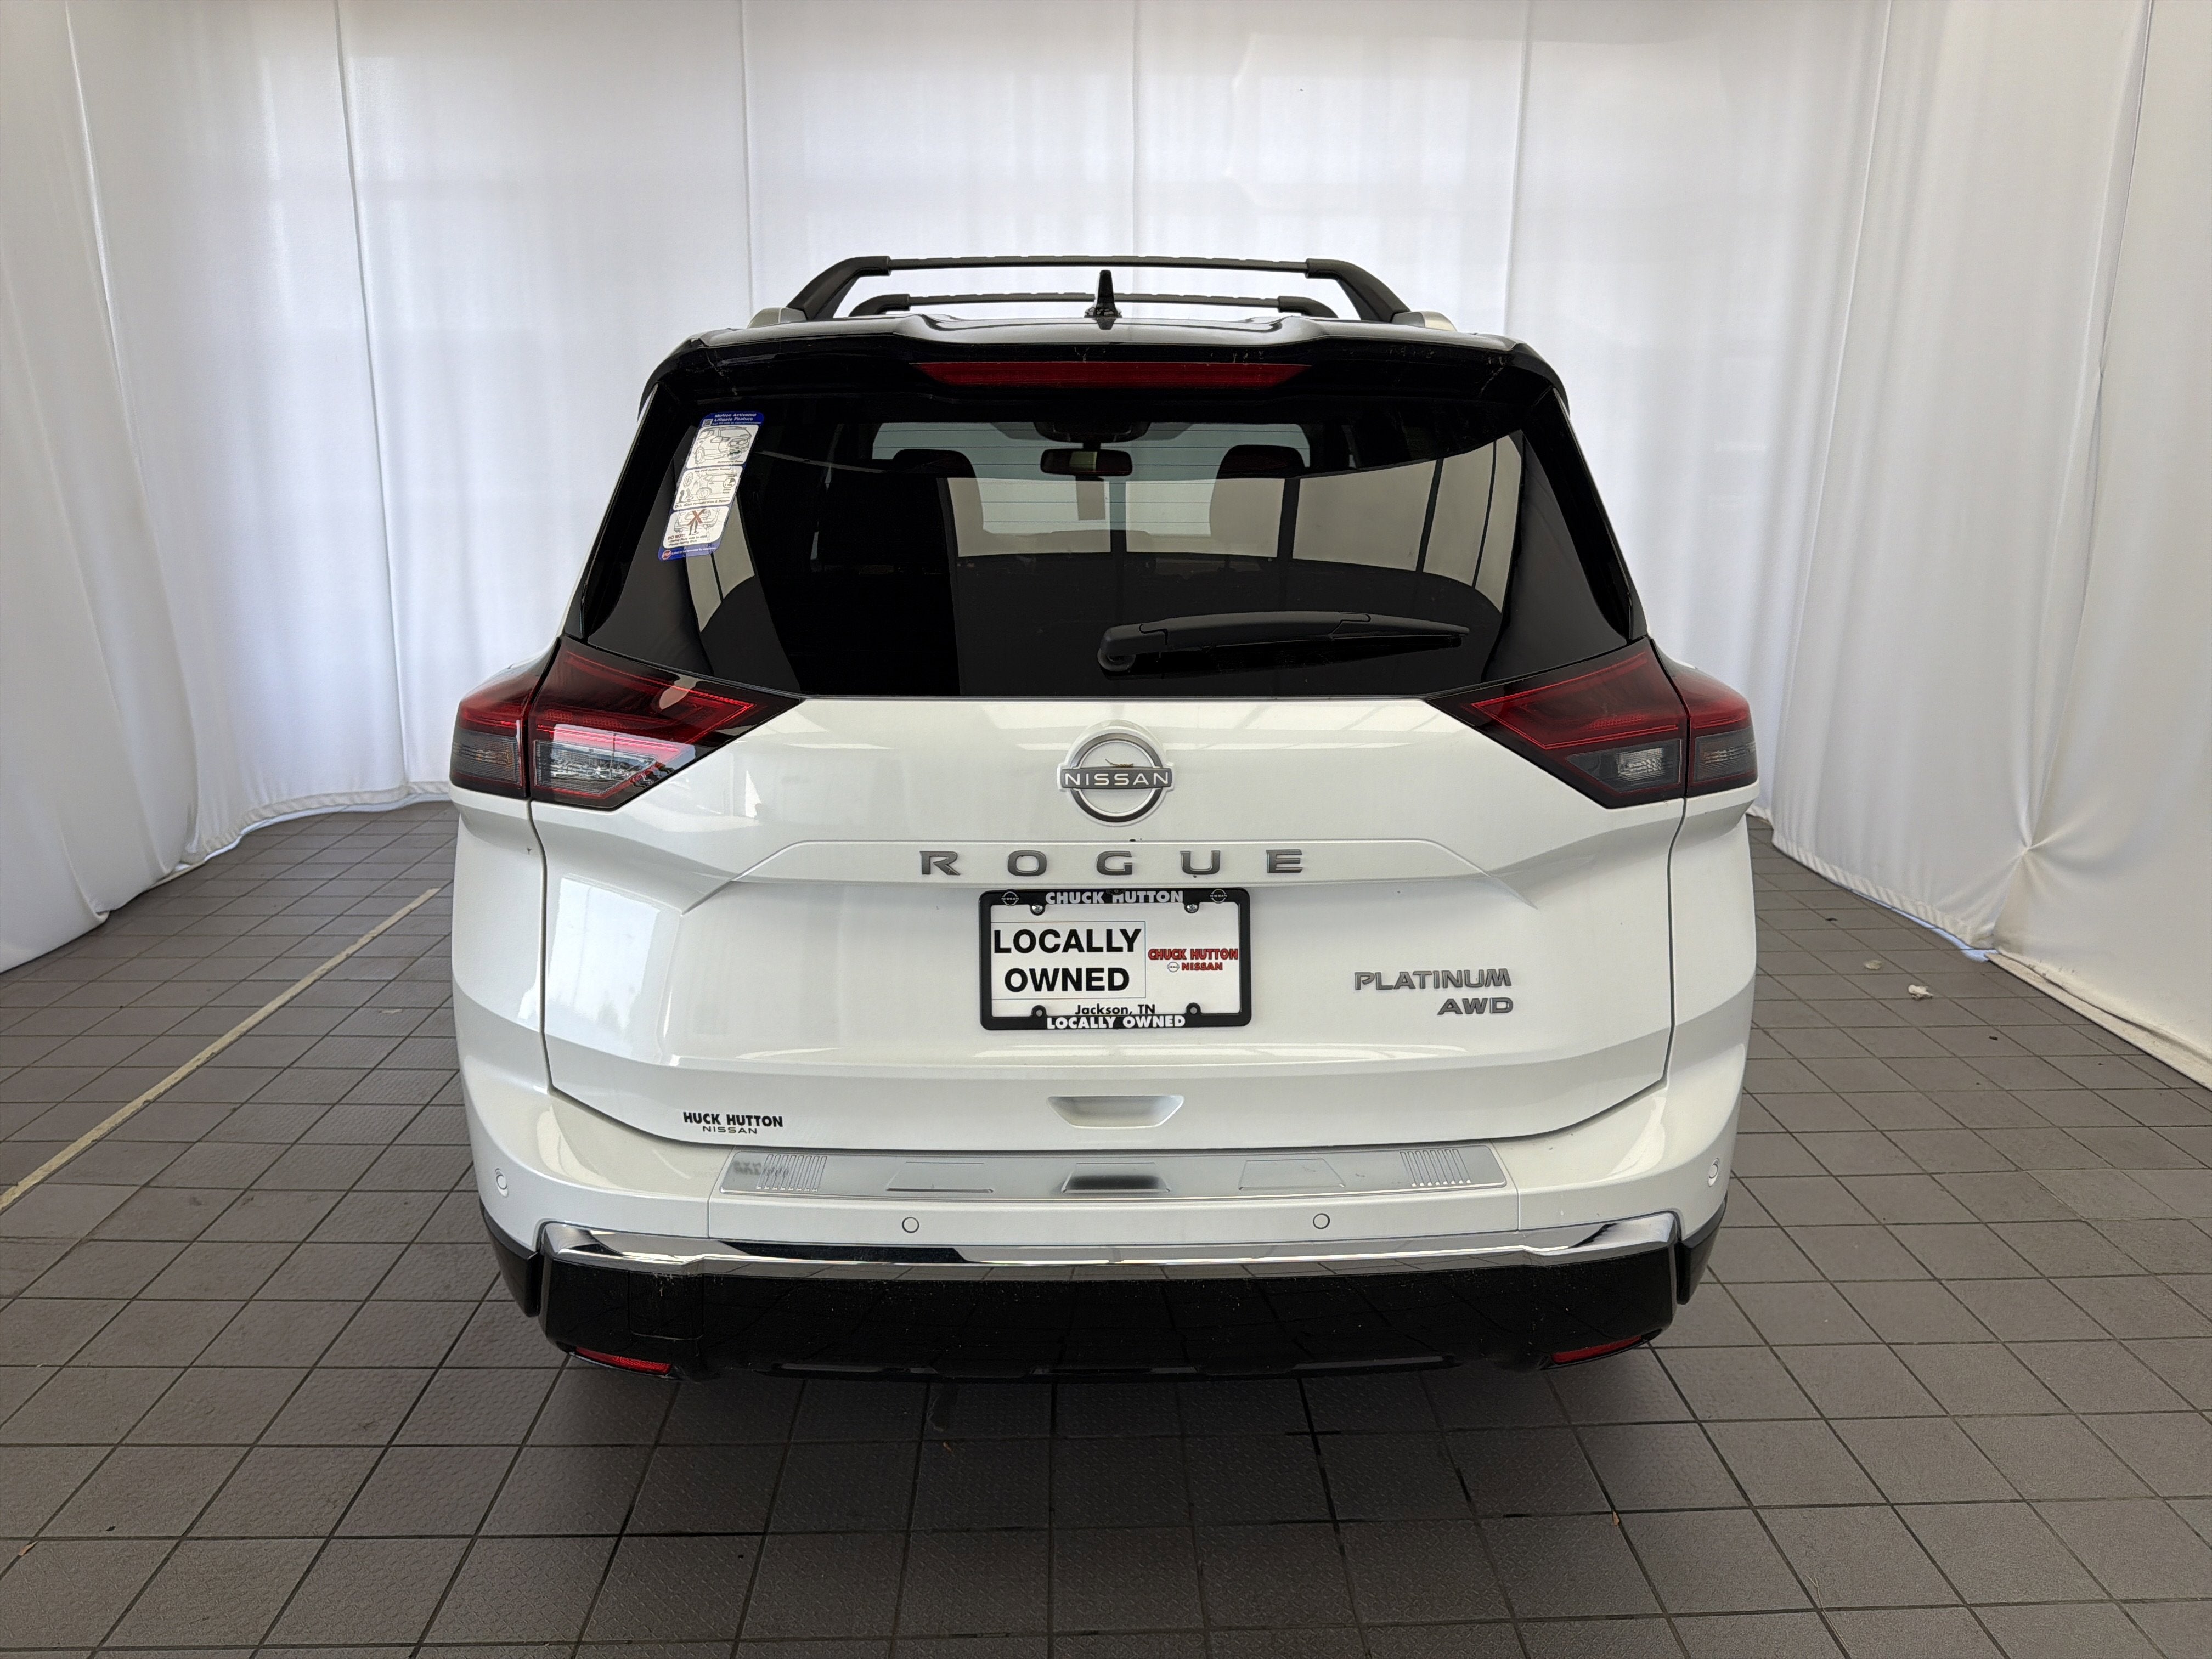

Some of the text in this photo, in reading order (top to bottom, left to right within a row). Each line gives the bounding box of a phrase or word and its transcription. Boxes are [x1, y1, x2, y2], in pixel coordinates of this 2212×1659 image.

[1065, 771, 1169, 786] NISSAN
[919, 849, 1304, 877] ROGUE
[1045, 890, 1183, 905] CHUCK HUTTON
[994, 928, 1142, 953] LOCALLY
[1148, 948, 1238, 960] CHUCK HUTTON
[1181, 962, 1223, 970] NISSAN
[1005, 967, 1130, 992] OWNED
[1354, 968, 1512, 990] PLATINUM
[1075, 1003, 1155, 1015] Jackson, TN
[1437, 997, 1514, 1015] AWD
[1047, 1015, 1186, 1029] LOCALLY OWNED
[683, 1111, 783, 1127] HUCK HUTTON
[702, 1126, 757, 1135] NISSAN
